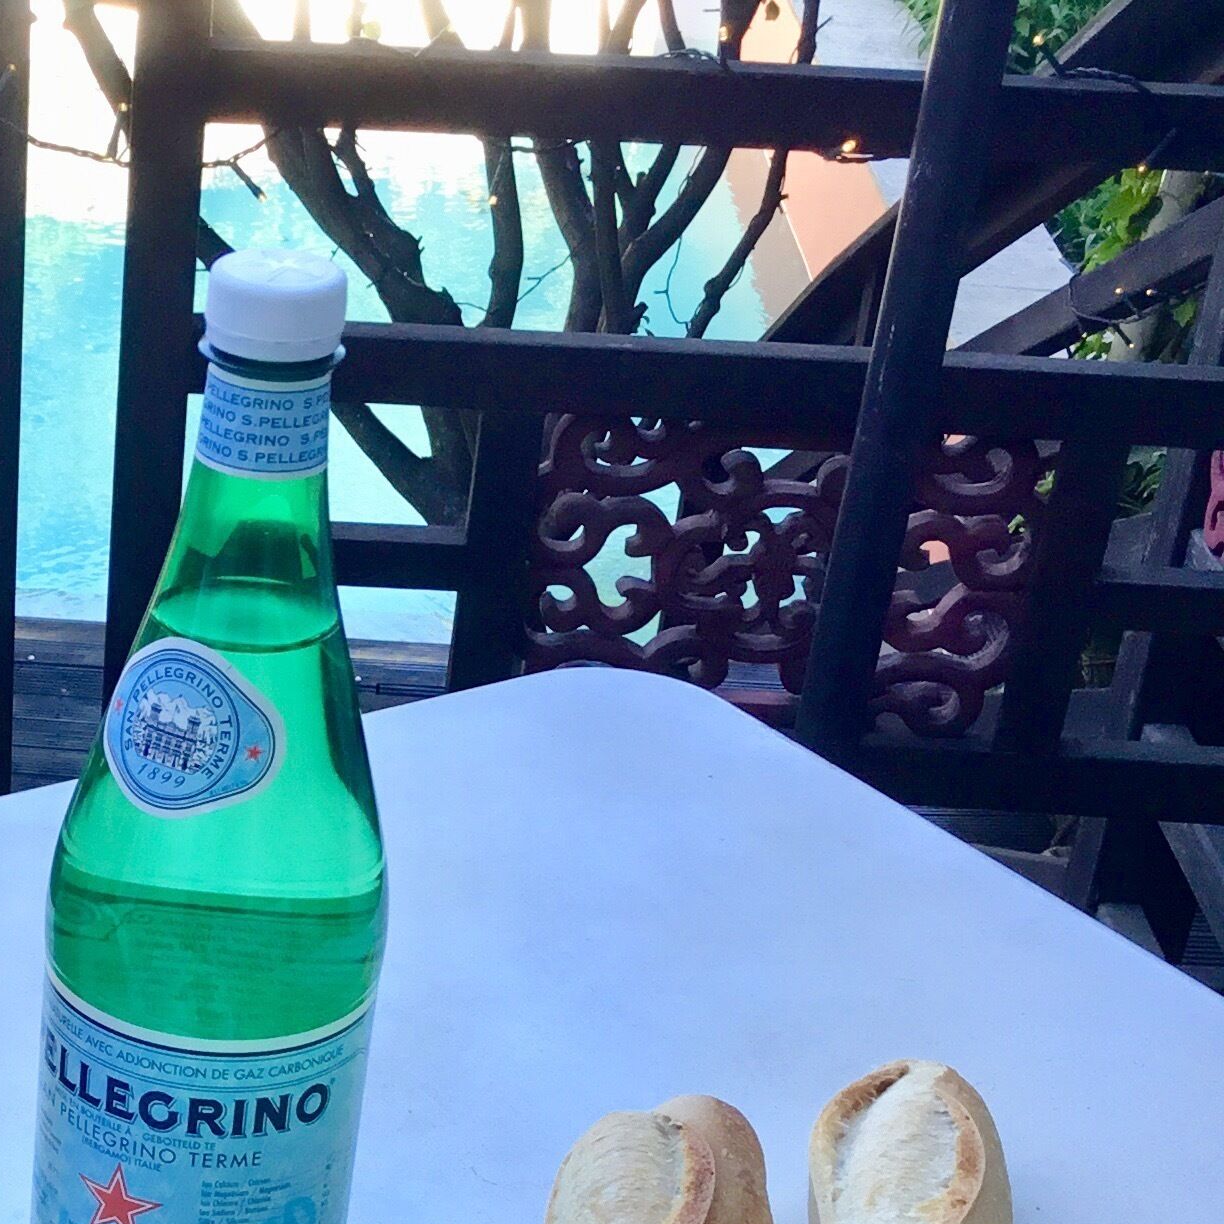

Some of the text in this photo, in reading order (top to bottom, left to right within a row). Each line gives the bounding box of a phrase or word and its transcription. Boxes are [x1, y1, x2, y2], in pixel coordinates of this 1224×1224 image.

[133, 667, 224, 709] PELLEGRINO
[201, 714, 233, 780] TERME
[137, 763, 186, 789] 1899
[85, 1034, 113, 1057] AVEC
[116, 1050, 211, 1079] ADJONCTION
[212, 1068, 229, 1080] DE
[234, 1068, 264, 1080] GAZ
[268, 1043, 344, 1078] CARBONIQUE
[60, 1102, 176, 1163] PELLEGRINO
[189, 1151, 263, 1168] TERME
